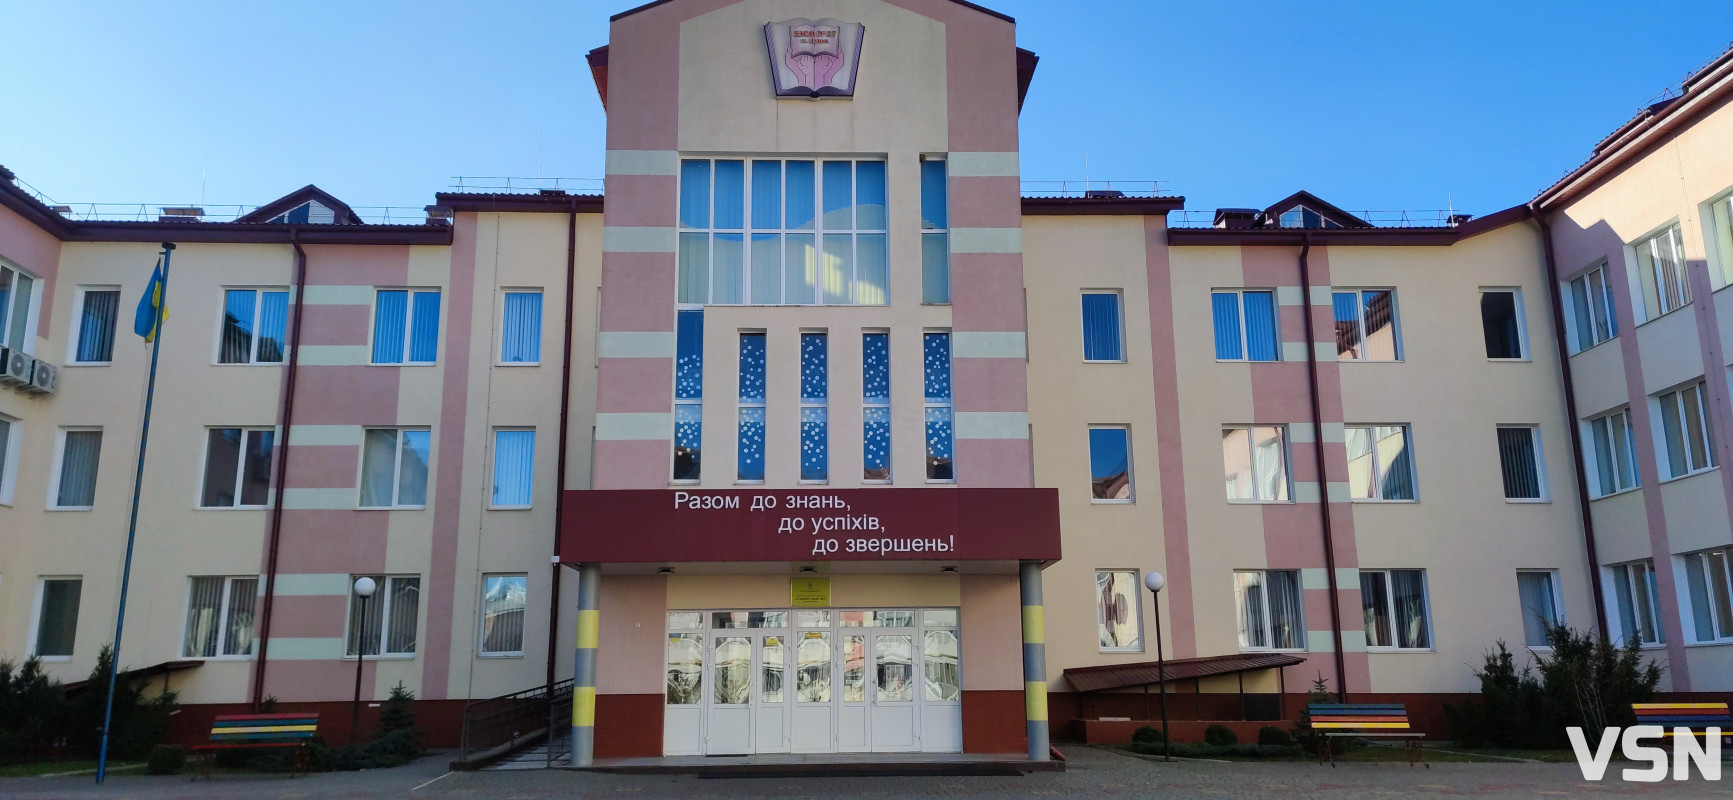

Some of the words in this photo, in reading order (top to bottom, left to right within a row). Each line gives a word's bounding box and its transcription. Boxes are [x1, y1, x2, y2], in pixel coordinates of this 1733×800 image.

[674, 491, 740, 509] Разом
[750, 495, 777, 512] до
[785, 495, 852, 512] знань,
[778, 517, 805, 534] до
[810, 513, 886, 534] успіхів,
[812, 538, 839, 556] до
[845, 534, 955, 556] звершень!
